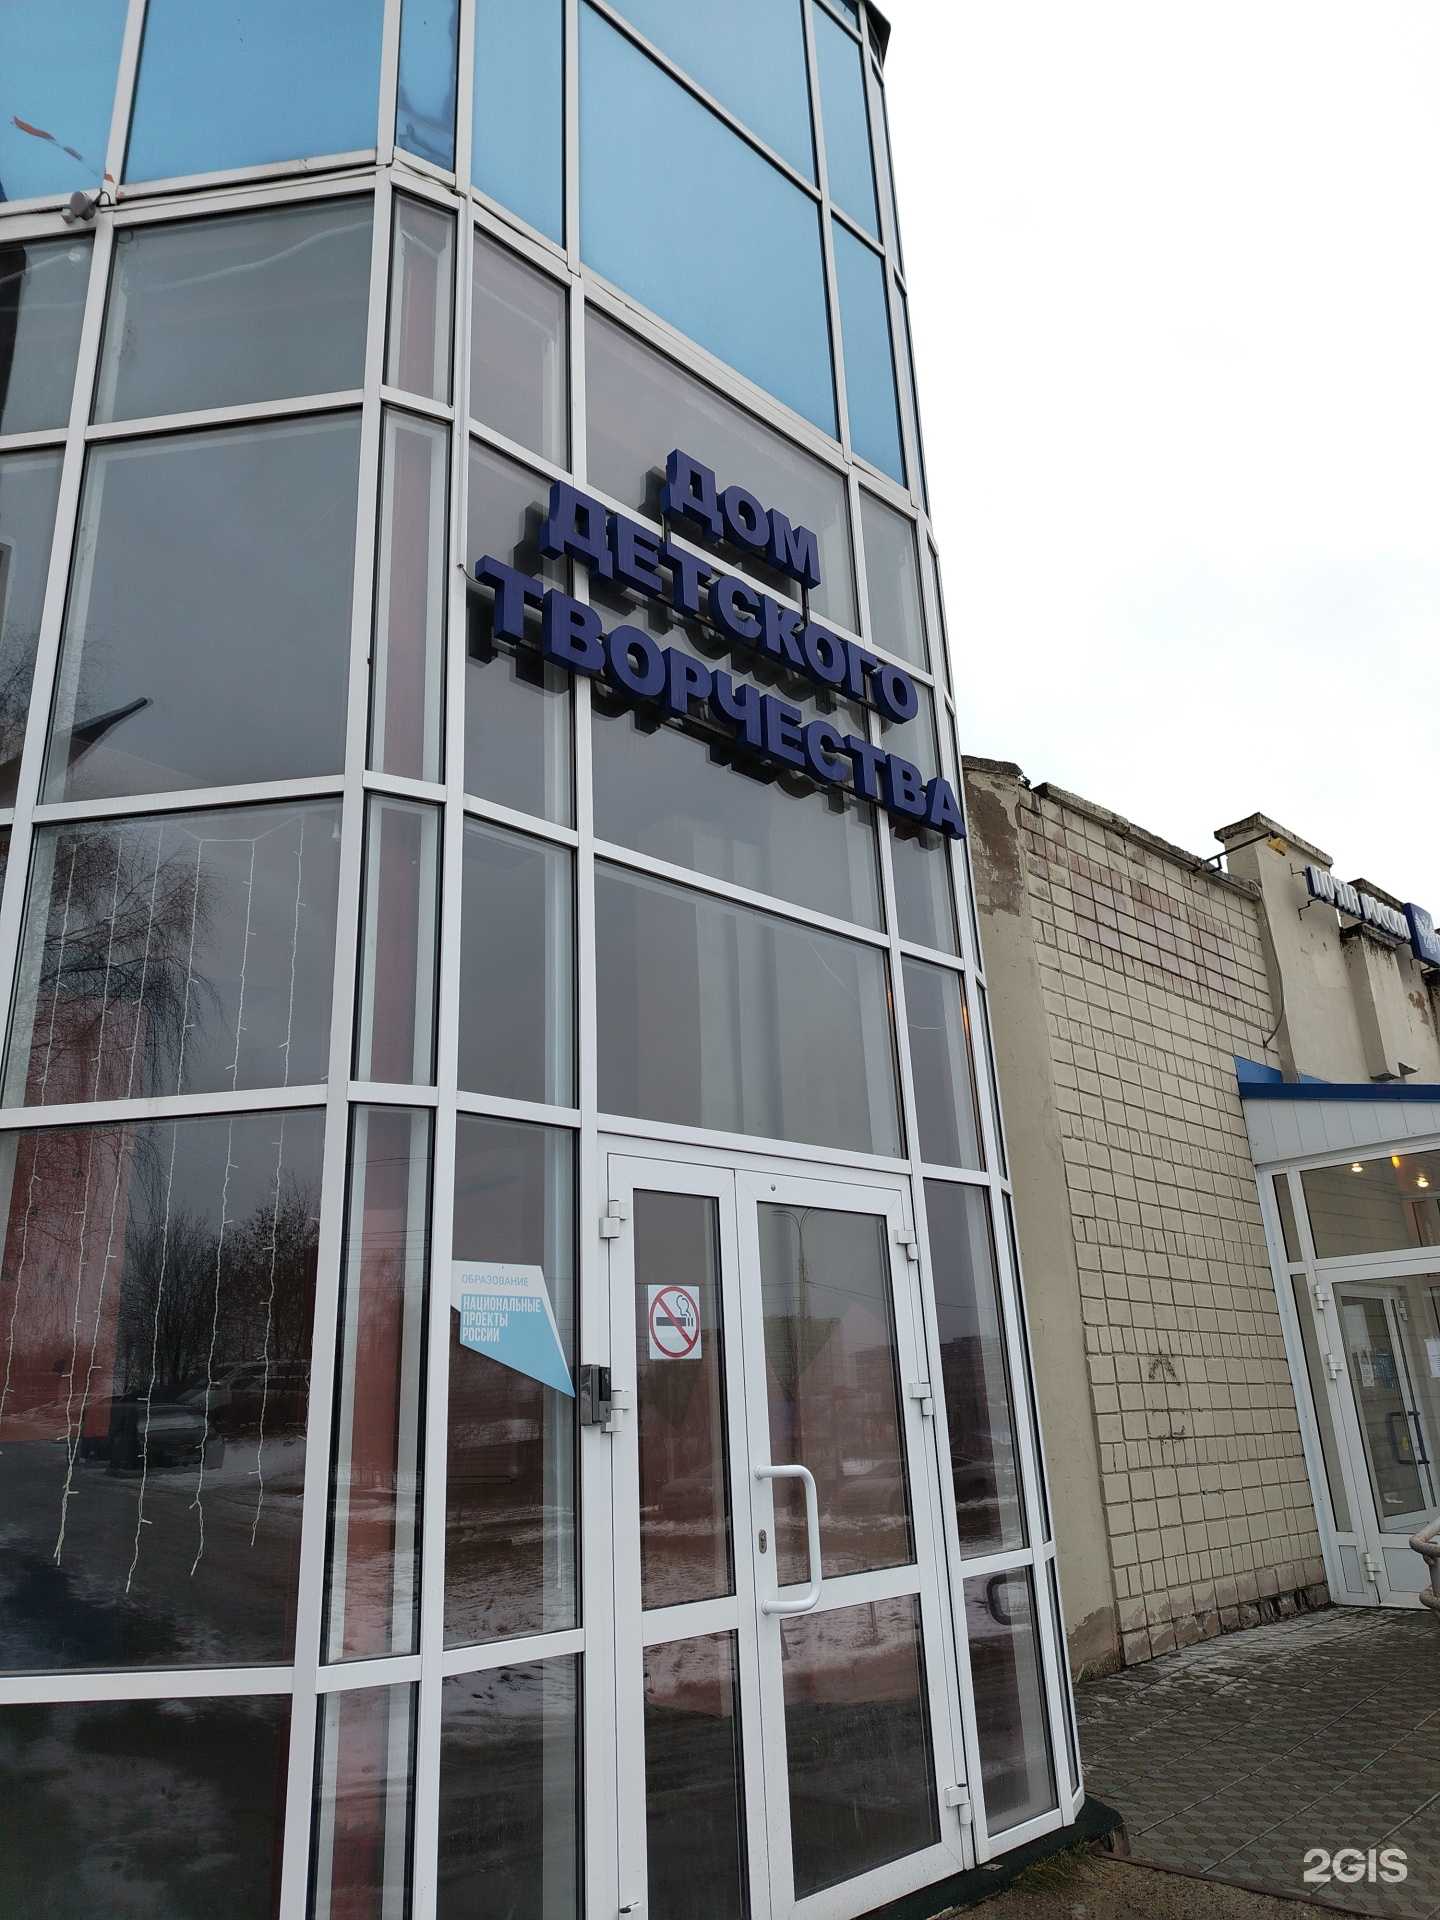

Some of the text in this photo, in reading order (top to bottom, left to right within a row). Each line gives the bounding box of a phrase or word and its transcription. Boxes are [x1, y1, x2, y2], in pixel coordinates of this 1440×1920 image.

[662, 449, 820, 589] ДОМ
[541, 480, 918, 724] ДЕТСКОГО
[475, 555, 965, 840] ТВОРЧЕСТВА
[462, 1273, 529, 1287] ОБРАЗОВАНИЕ
[463, 1295, 542, 1313] НАЦИОНАЛЬНЫЕ
[463, 1311, 509, 1327] ПРОЕКТЫ
[463, 1327, 500, 1342] РОССИИ
